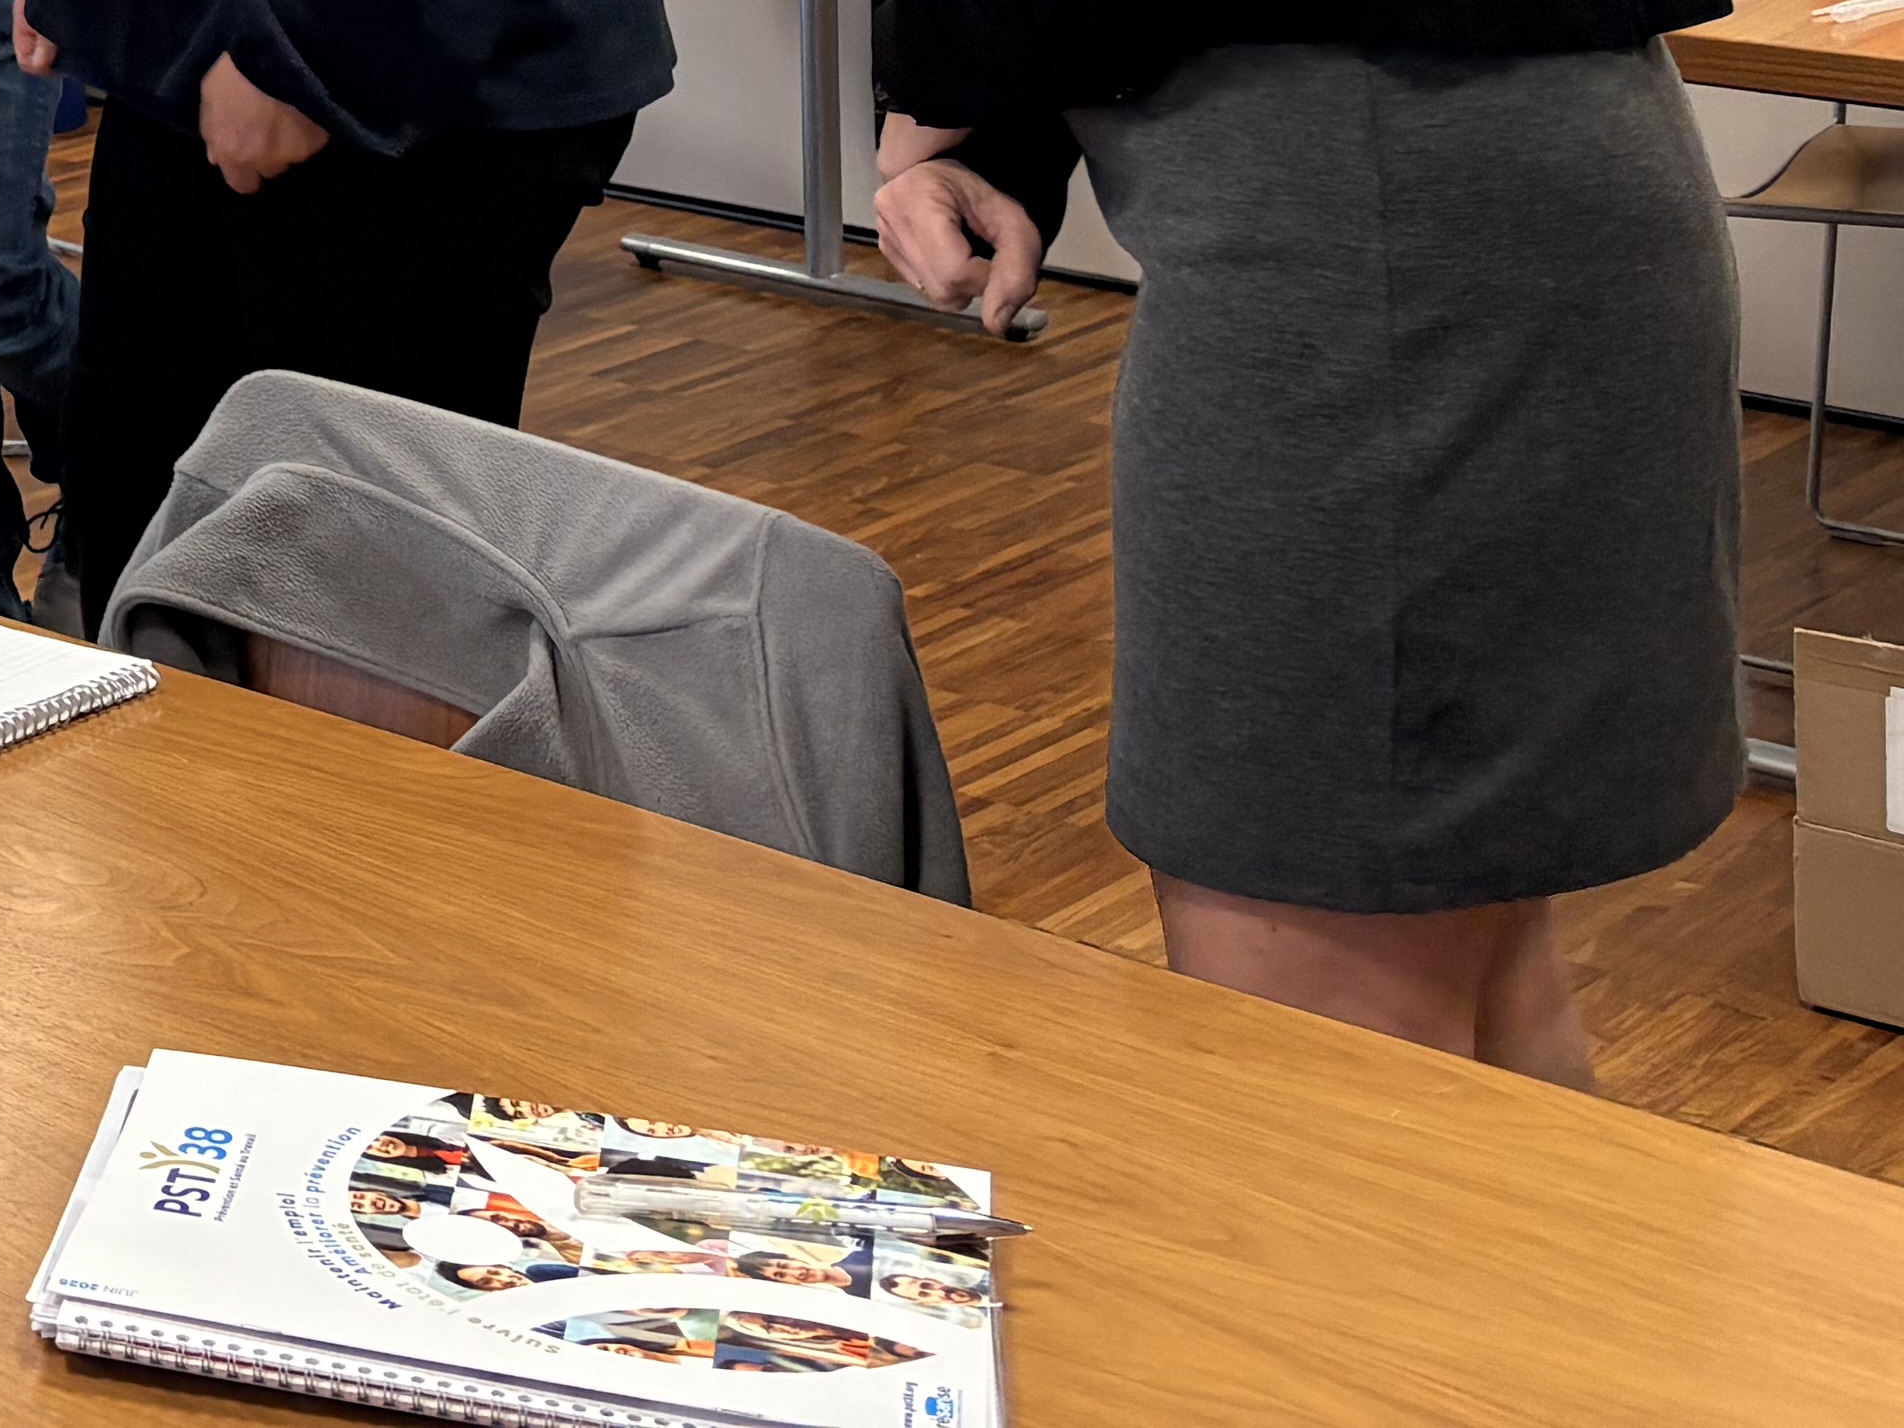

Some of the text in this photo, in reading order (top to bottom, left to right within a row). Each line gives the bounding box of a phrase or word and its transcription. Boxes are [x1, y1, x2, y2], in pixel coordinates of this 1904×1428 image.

[153, 1126, 233, 1217] PST 38
[213, 1190, 236, 1222] Prévention
[240, 1133, 256, 1154] Travail
[304, 1126, 361, 1194] prévention
[276, 1192, 403, 1309] Maintenir l'emploi
[311, 1211, 373, 1275] Améliorer
[332, 1222, 372, 1259] santé
[103, 1286, 139, 1297] JUIN
[467, 1316, 561, 1354] Suivre
